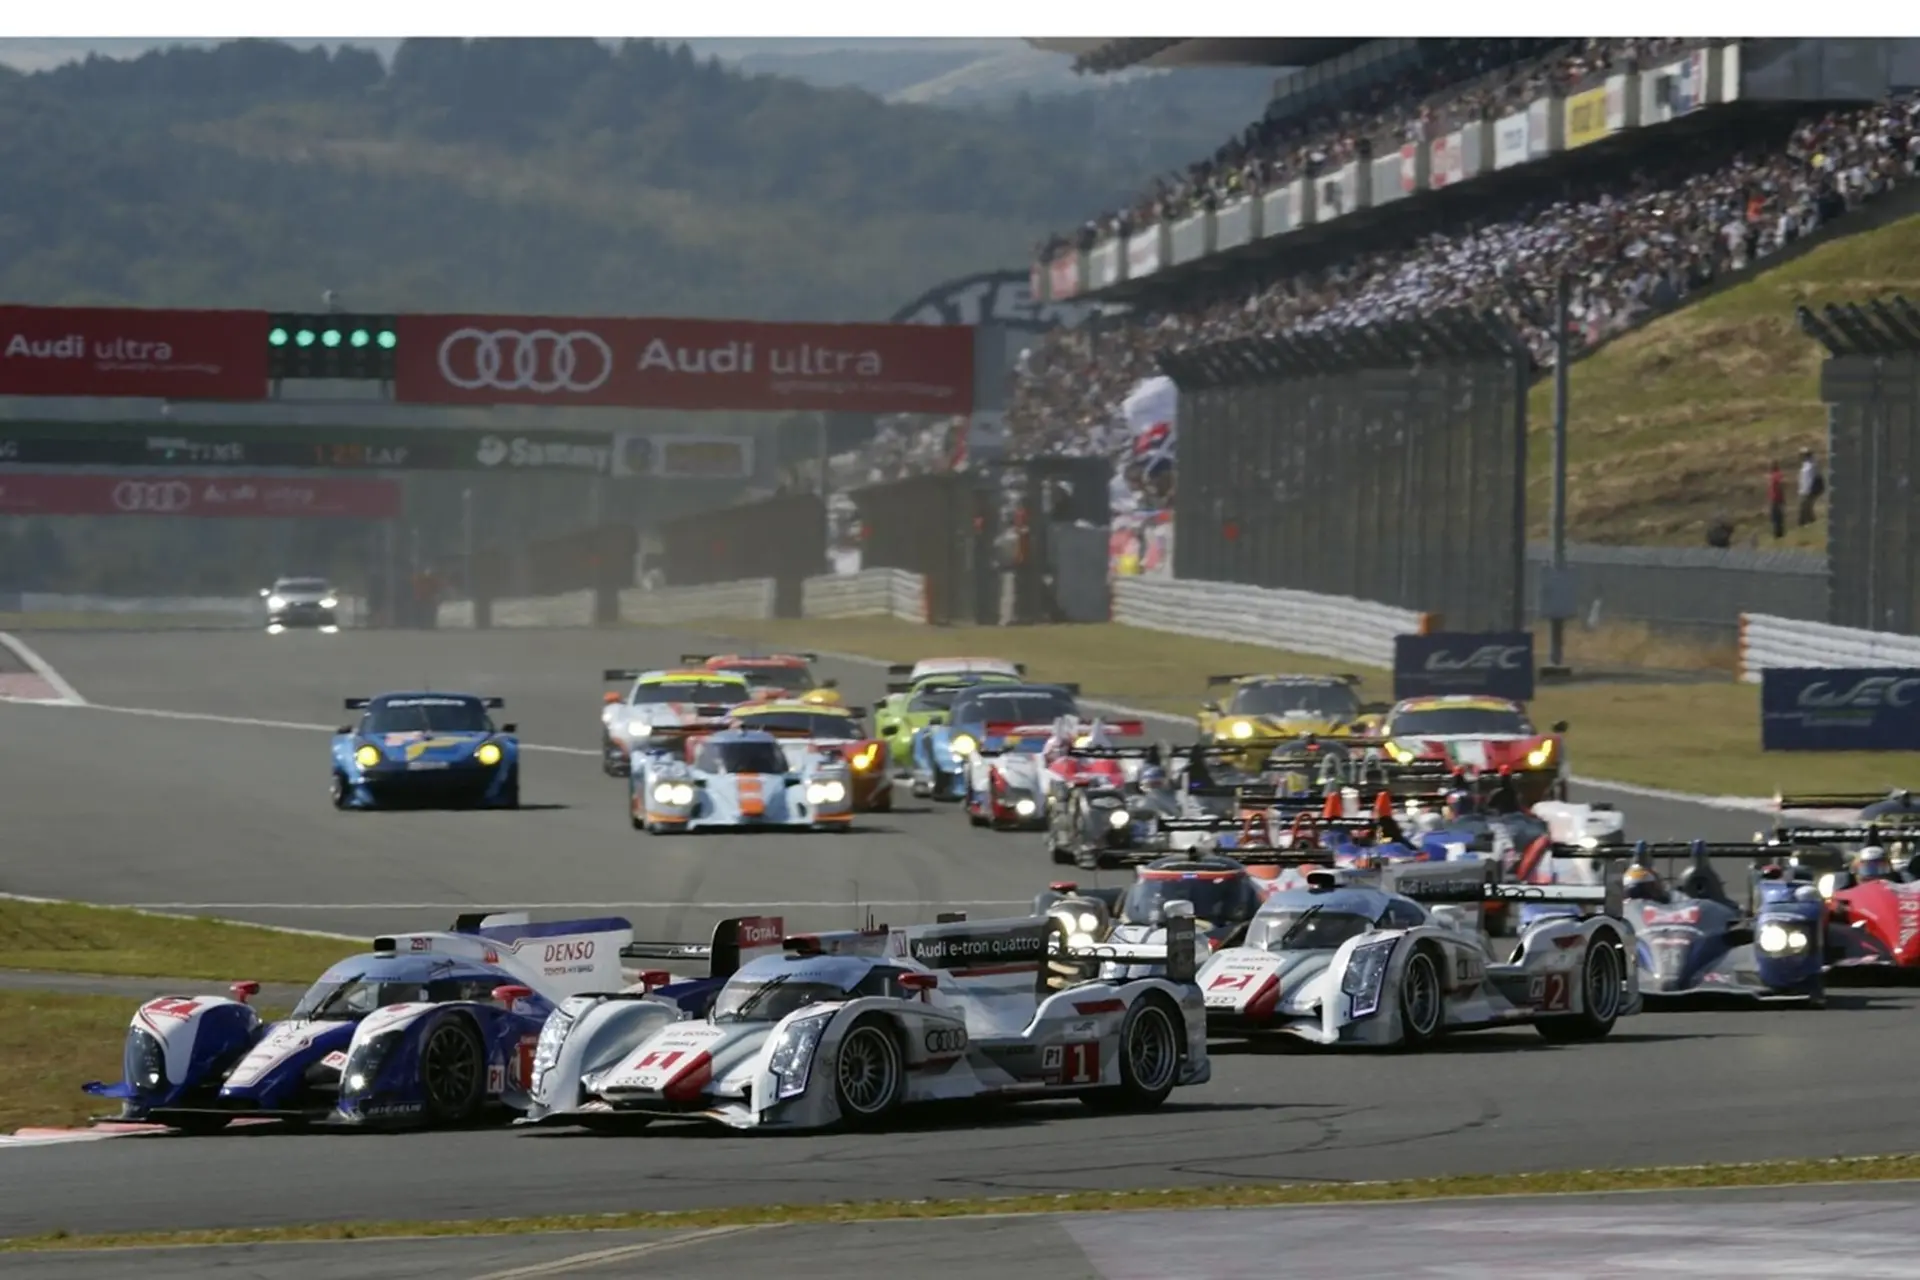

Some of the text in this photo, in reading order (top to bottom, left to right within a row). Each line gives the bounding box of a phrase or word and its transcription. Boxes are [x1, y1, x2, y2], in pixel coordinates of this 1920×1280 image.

[4, 333, 172, 361] Audi ultra
[639, 337, 881, 376] Audi ultra
[744, 925, 780, 941] TOTAL
[544, 940, 595, 962] DENSO
[916, 937, 1040, 957] Audi e-tron quattro
[1549, 974, 1565, 1010] 2
[1045, 1047, 1060, 1066] P1
[1072, 1044, 1091, 1083] 1
[489, 1069, 503, 1090] P1
